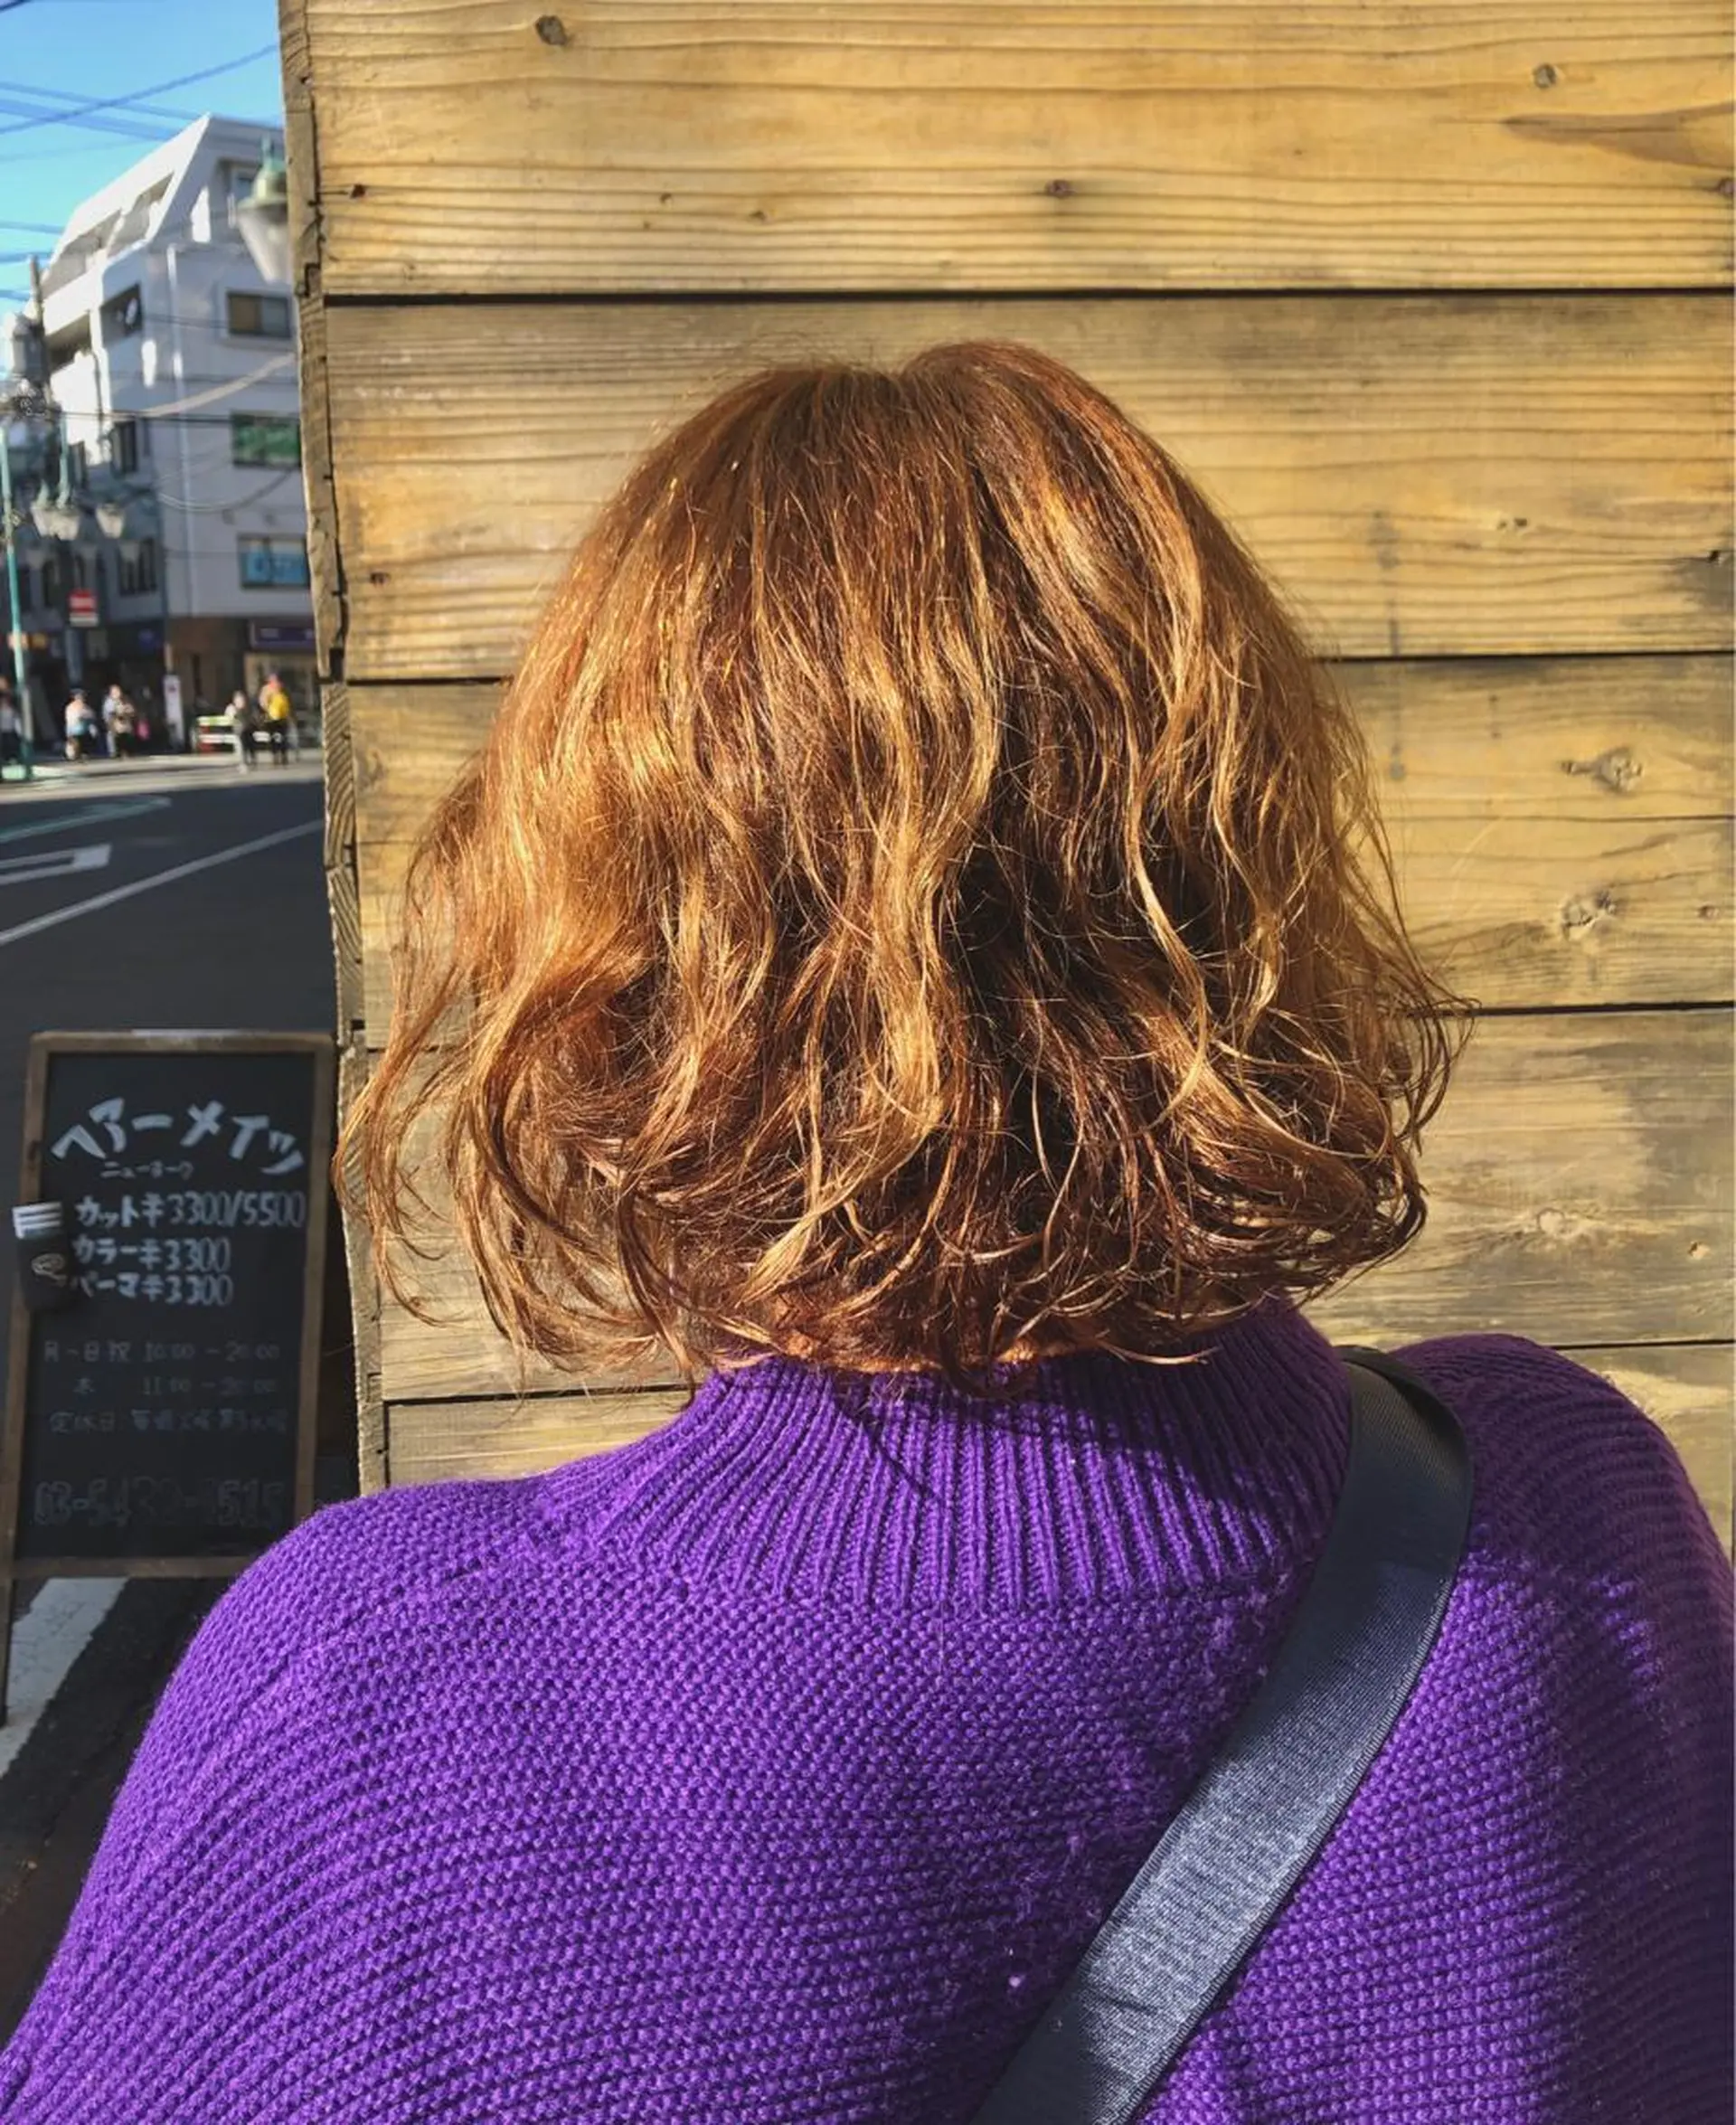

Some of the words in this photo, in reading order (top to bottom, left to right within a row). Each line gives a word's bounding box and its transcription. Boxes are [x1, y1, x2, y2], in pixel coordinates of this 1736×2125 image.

[51, 1097, 304, 1174] ヘアーメイツ
